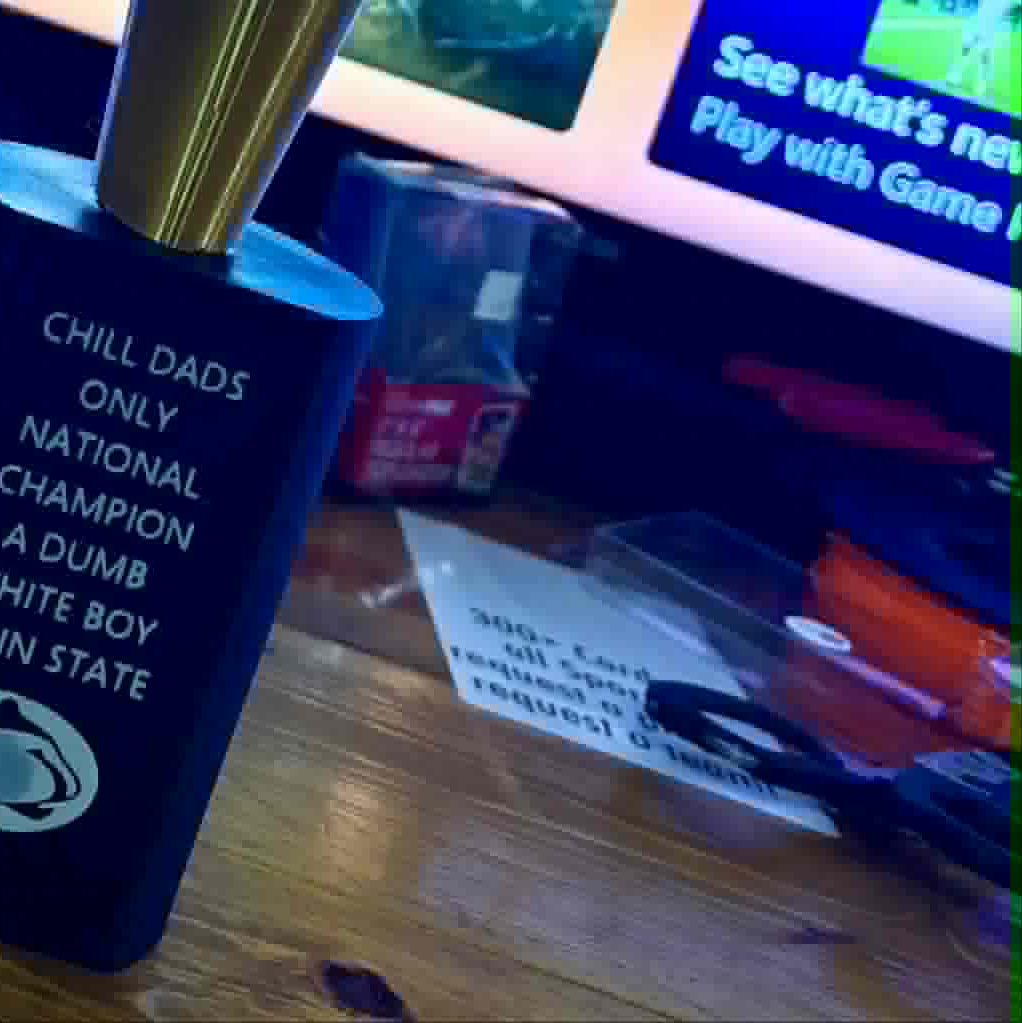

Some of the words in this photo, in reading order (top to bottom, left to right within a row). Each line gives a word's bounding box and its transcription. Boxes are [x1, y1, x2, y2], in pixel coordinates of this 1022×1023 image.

[713, 33, 800, 97] See
[803, 69, 948, 148] what's
[690, 94, 781, 166] Play
[784, 134, 875, 192] with
[878, 160, 1003, 233] Game
[43, 311, 138, 369] CHILL
[147, 344, 250, 401] DADS
[79, 378, 179, 433] ONLY
[19, 415, 201, 500] NATIONAL
[1, 523, 29, 555] A
[39, 532, 148, 590] DUMB
[83, 600, 159, 647] BOY
[43, 643, 152, 702] STATE
